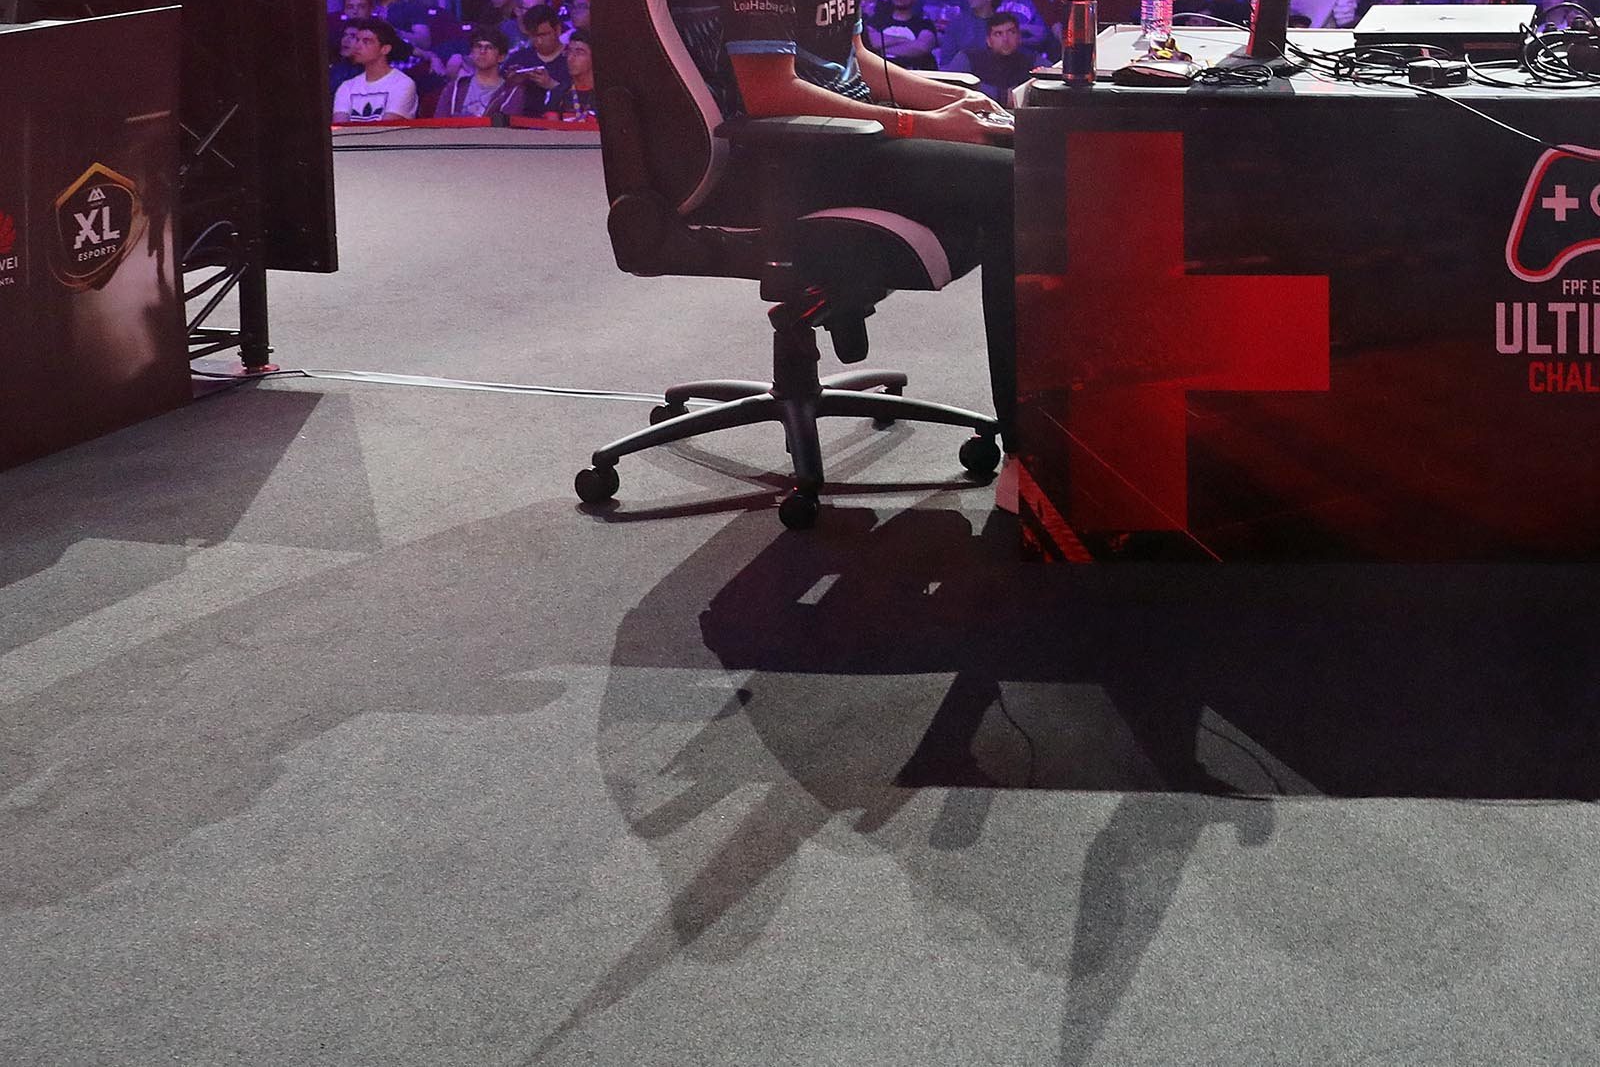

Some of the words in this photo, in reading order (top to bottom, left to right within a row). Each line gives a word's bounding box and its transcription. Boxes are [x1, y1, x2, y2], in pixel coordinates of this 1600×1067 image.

[73, 205, 120, 250] XL
[78, 244, 118, 262] ESPORTS
[1562, 279, 1587, 296] FPF
